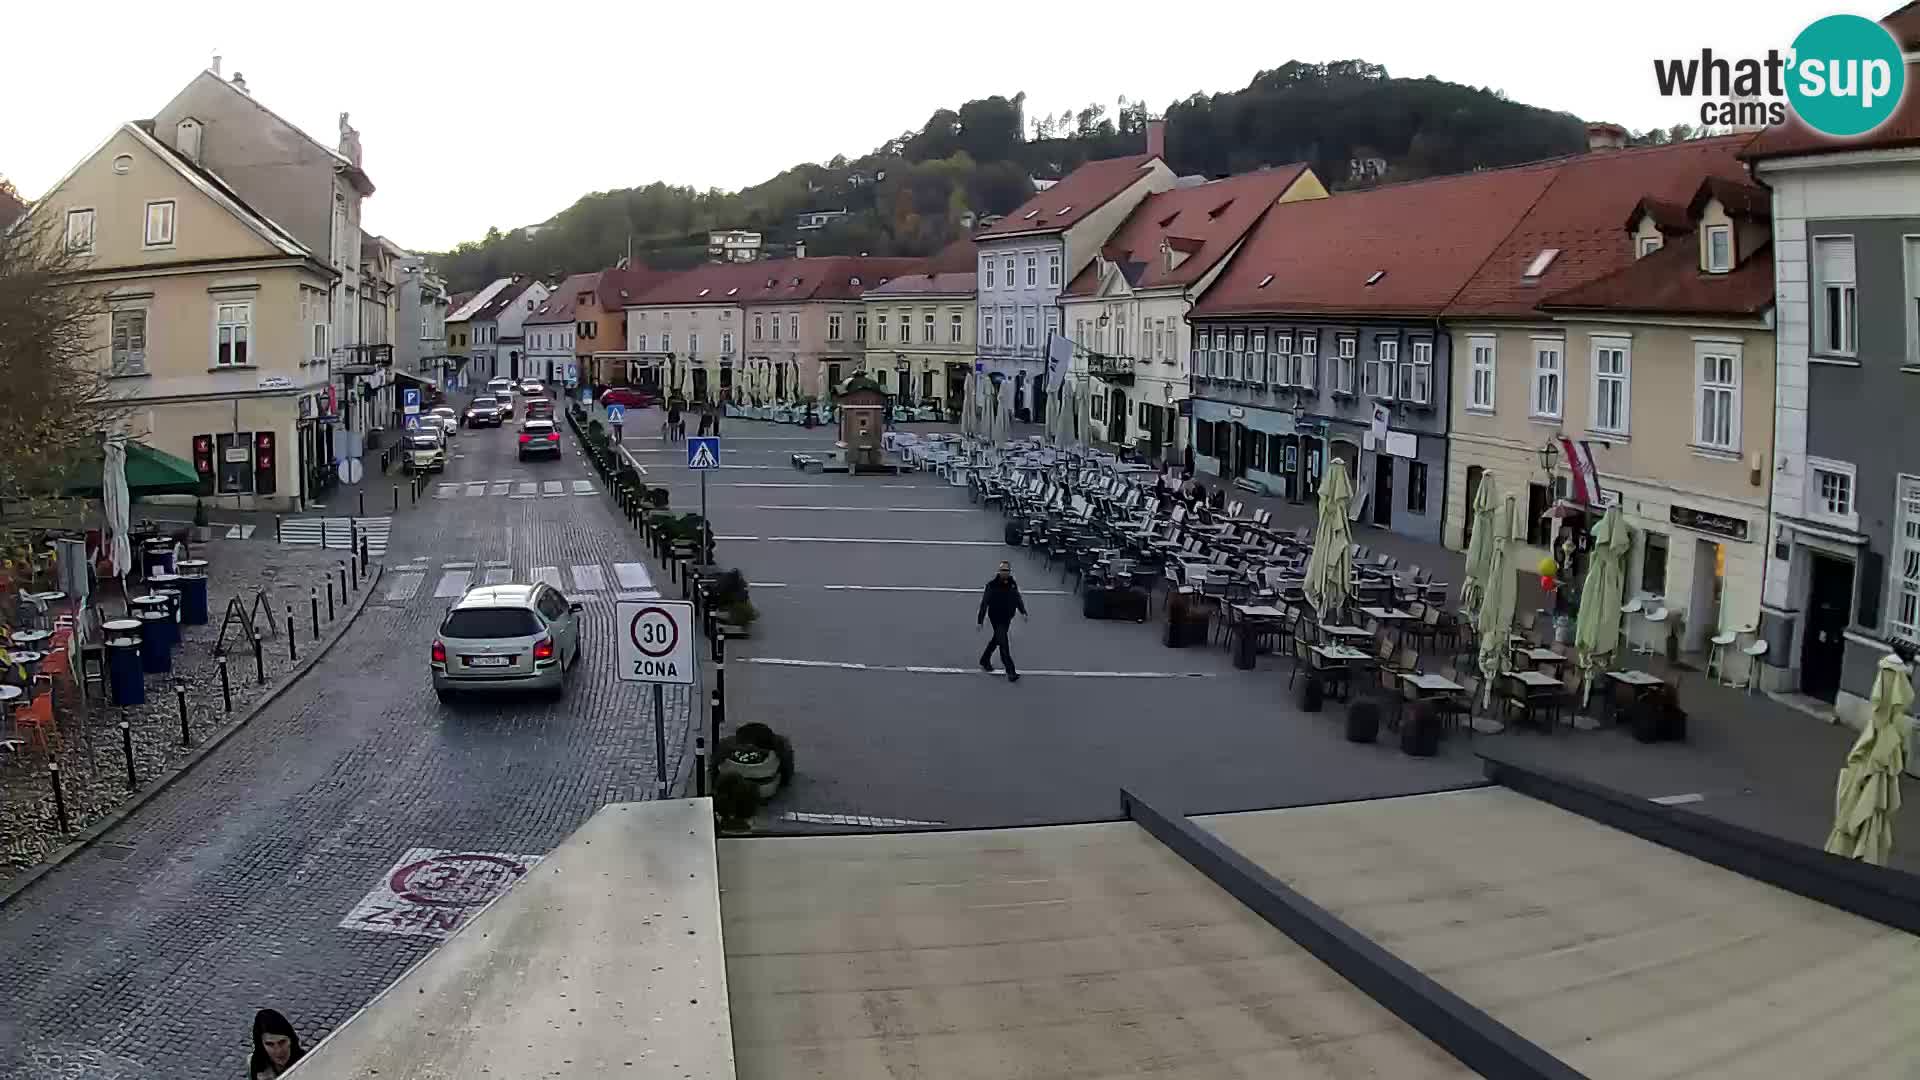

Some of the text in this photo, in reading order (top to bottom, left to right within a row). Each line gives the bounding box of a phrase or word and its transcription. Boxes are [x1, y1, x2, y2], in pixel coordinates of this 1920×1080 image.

[408, 392, 416, 403] P
[643, 623, 667, 643] 30
[634, 661, 677, 676] ZONA
